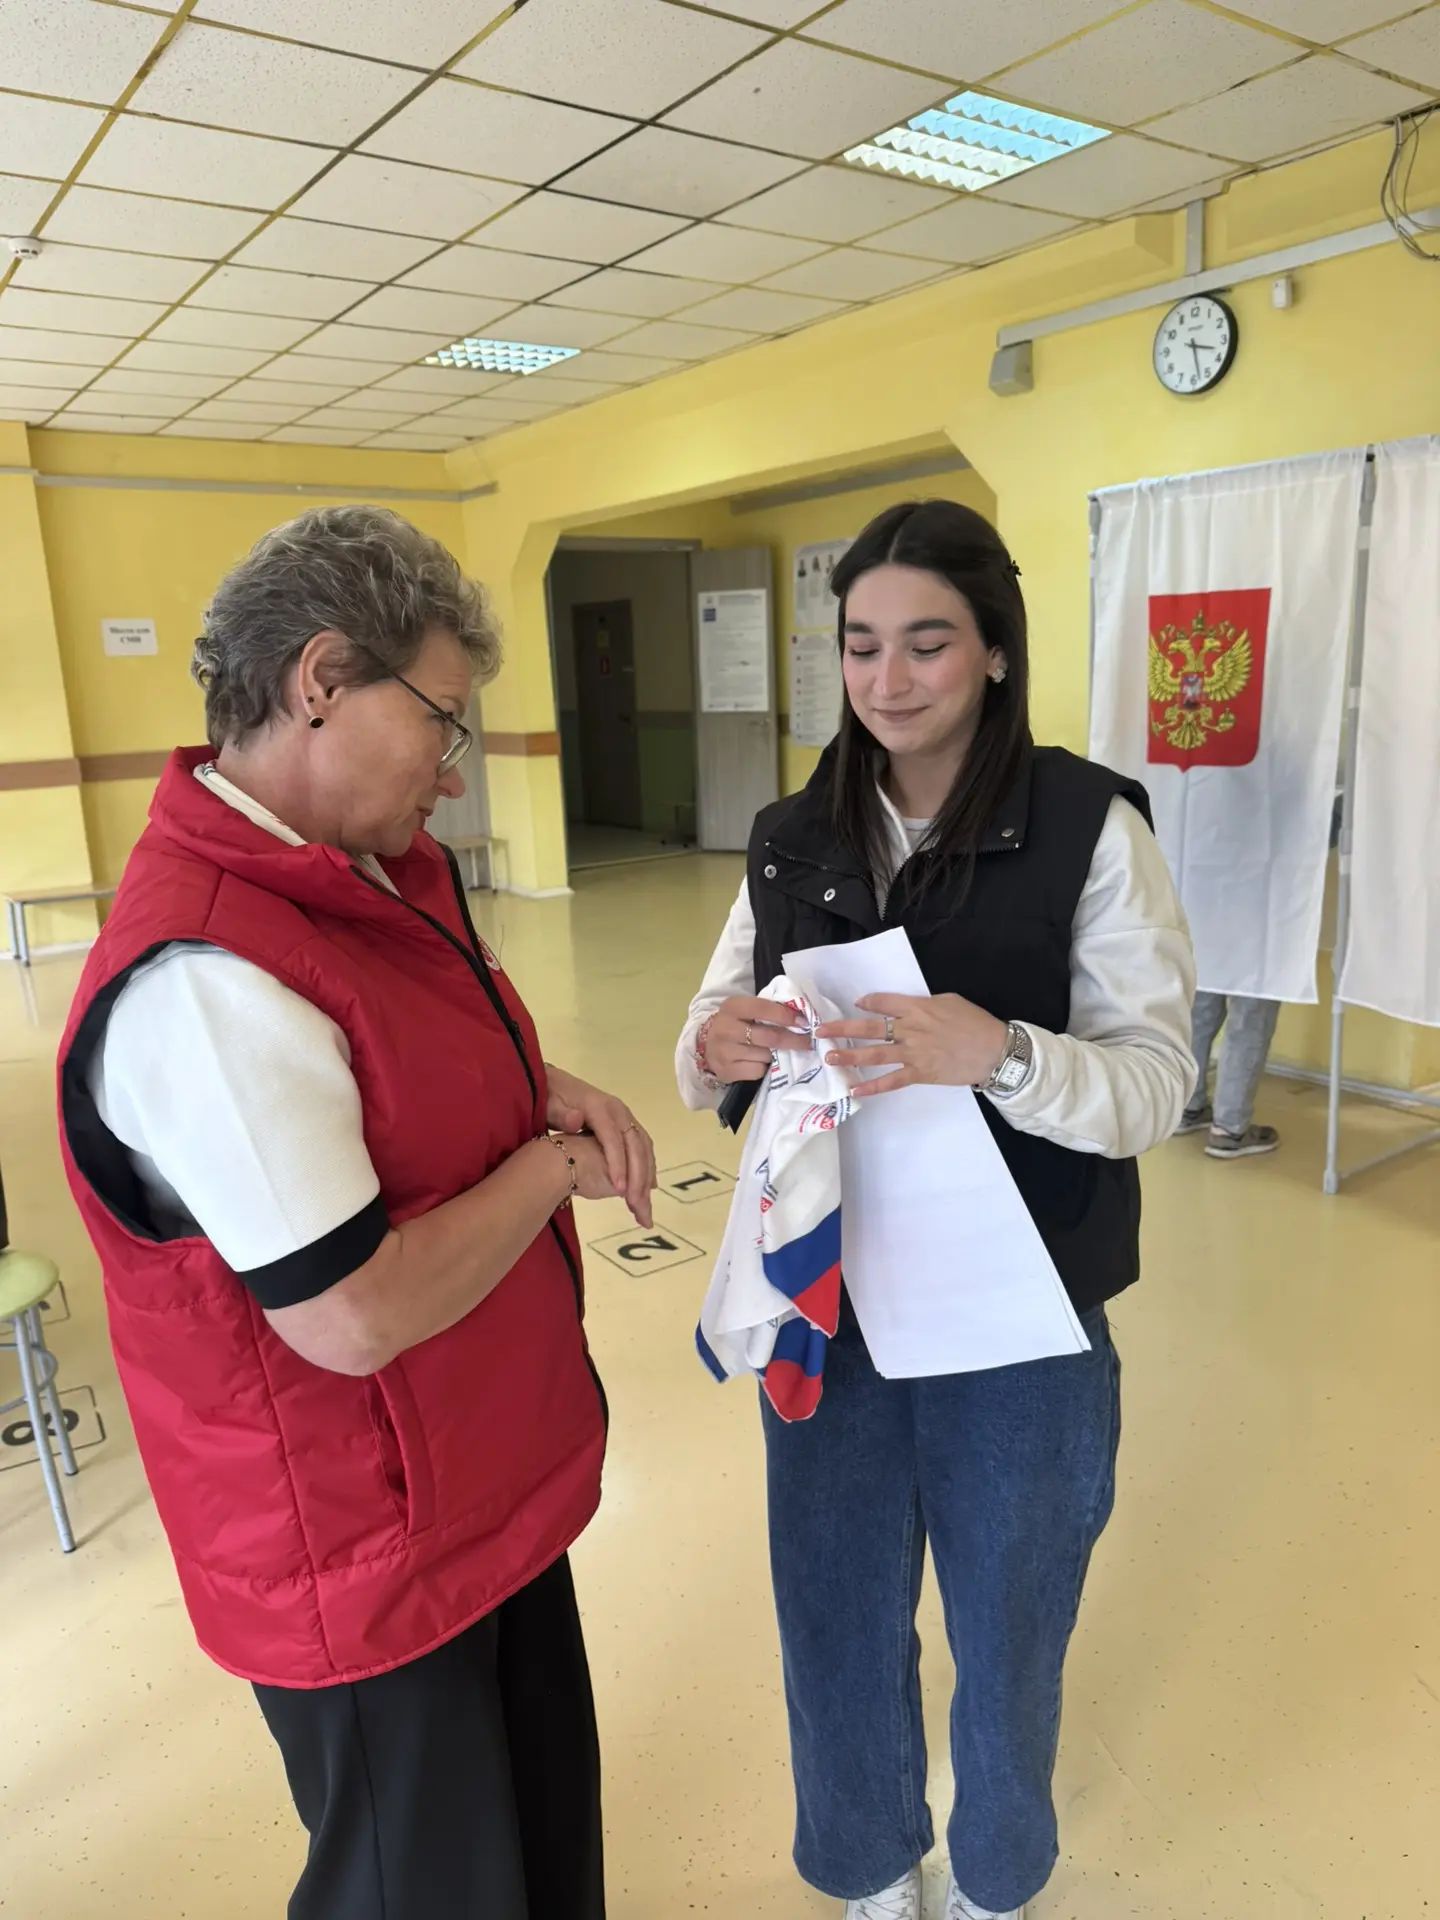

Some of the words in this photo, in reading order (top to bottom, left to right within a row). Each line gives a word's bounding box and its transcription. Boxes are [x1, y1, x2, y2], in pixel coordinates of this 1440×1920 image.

[1190, 306, 1200, 317] 12
[1216, 317, 1223, 328] 2
[1167, 329, 1176, 340] 10
[1220, 334, 1227, 345] 3
[1162, 347, 1170, 358] 9
[1215, 352, 1222, 362] 4
[1167, 363, 1174, 373] 8
[1204, 367, 1211, 378] 5
[1177, 373, 1184, 384] 7
[1190, 375, 1197, 386] 6
[670, 1171, 721, 1191] 1
[617, 1234, 679, 1262] 2
